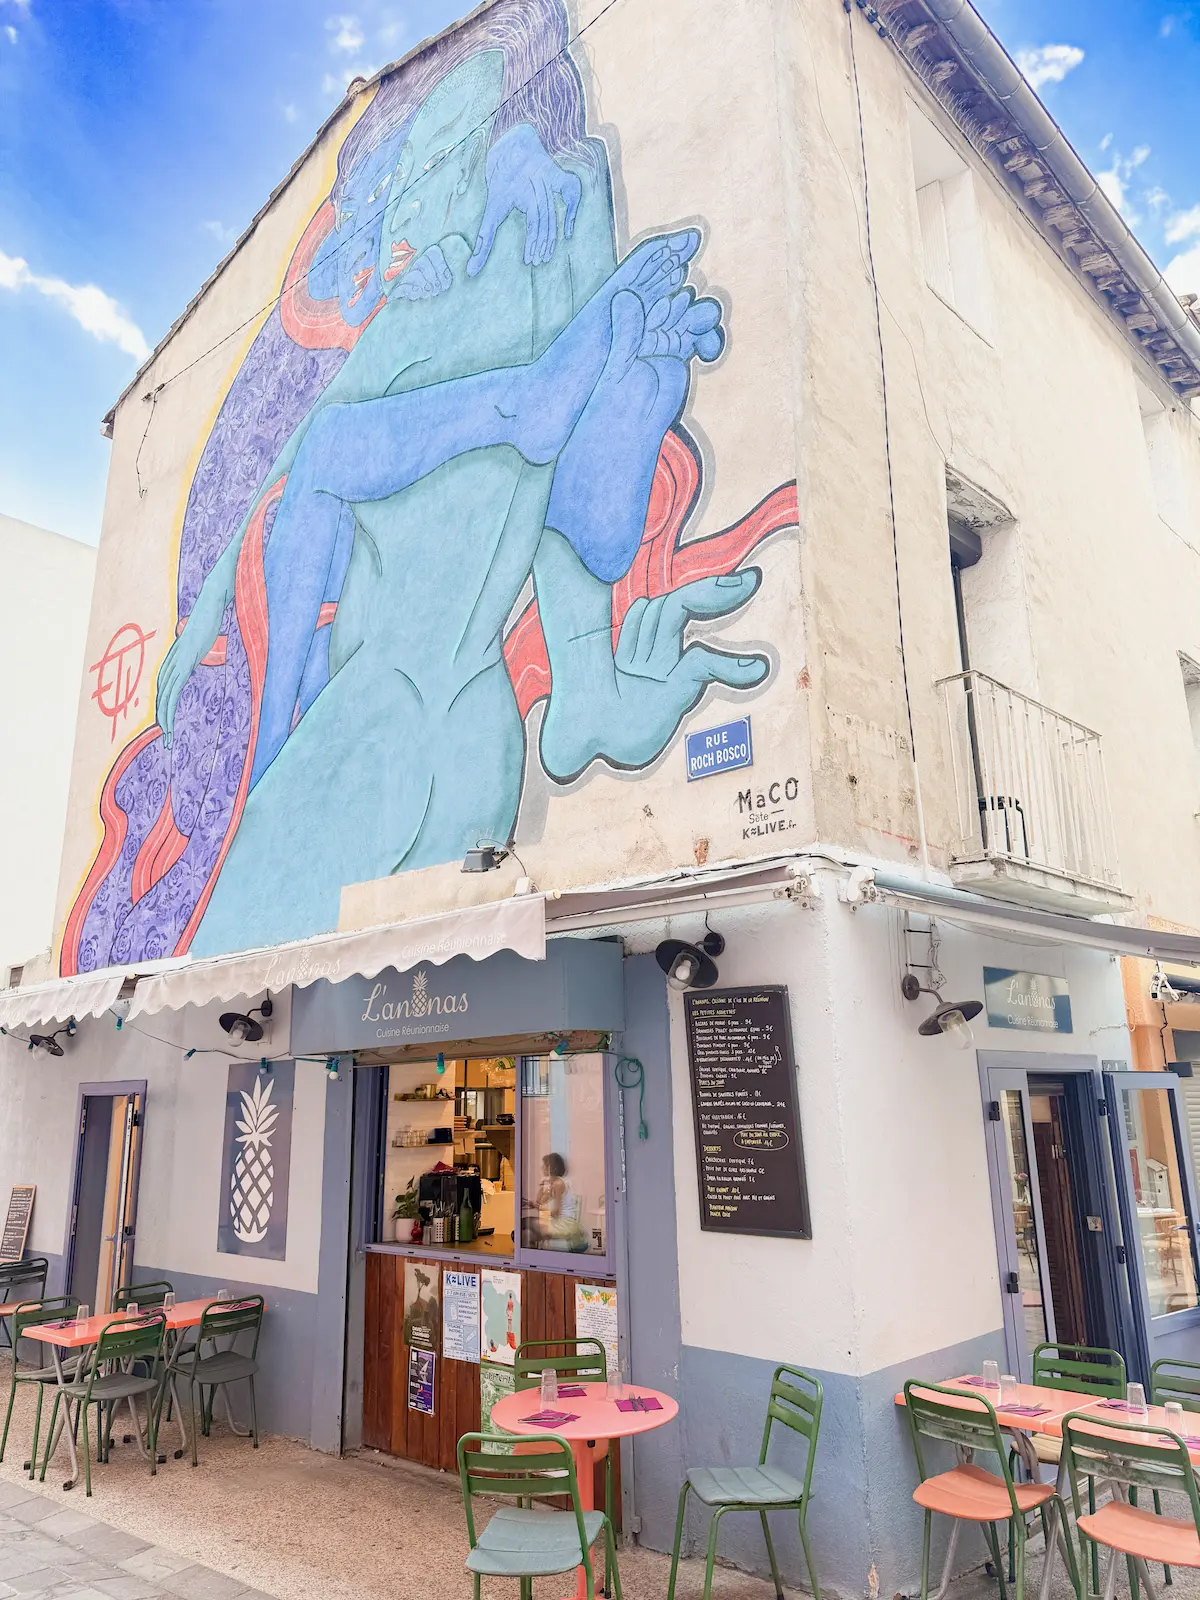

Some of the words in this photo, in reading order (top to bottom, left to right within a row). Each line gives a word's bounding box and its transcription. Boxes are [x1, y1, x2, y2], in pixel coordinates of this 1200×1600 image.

[705, 731, 729, 749] RUE
[690, 752, 715, 772] ROCH
[716, 743, 747, 765] BOSCO
[737, 777, 799, 813] MaCO
[401, 943, 436, 959] Cuisine
[437, 932, 507, 953] Réunionnaise
[376, 1026, 401, 1038] Cuisine
[401, 1022, 450, 1036] Réunionnaise
[1008, 1014, 1027, 1026] Cuisine
